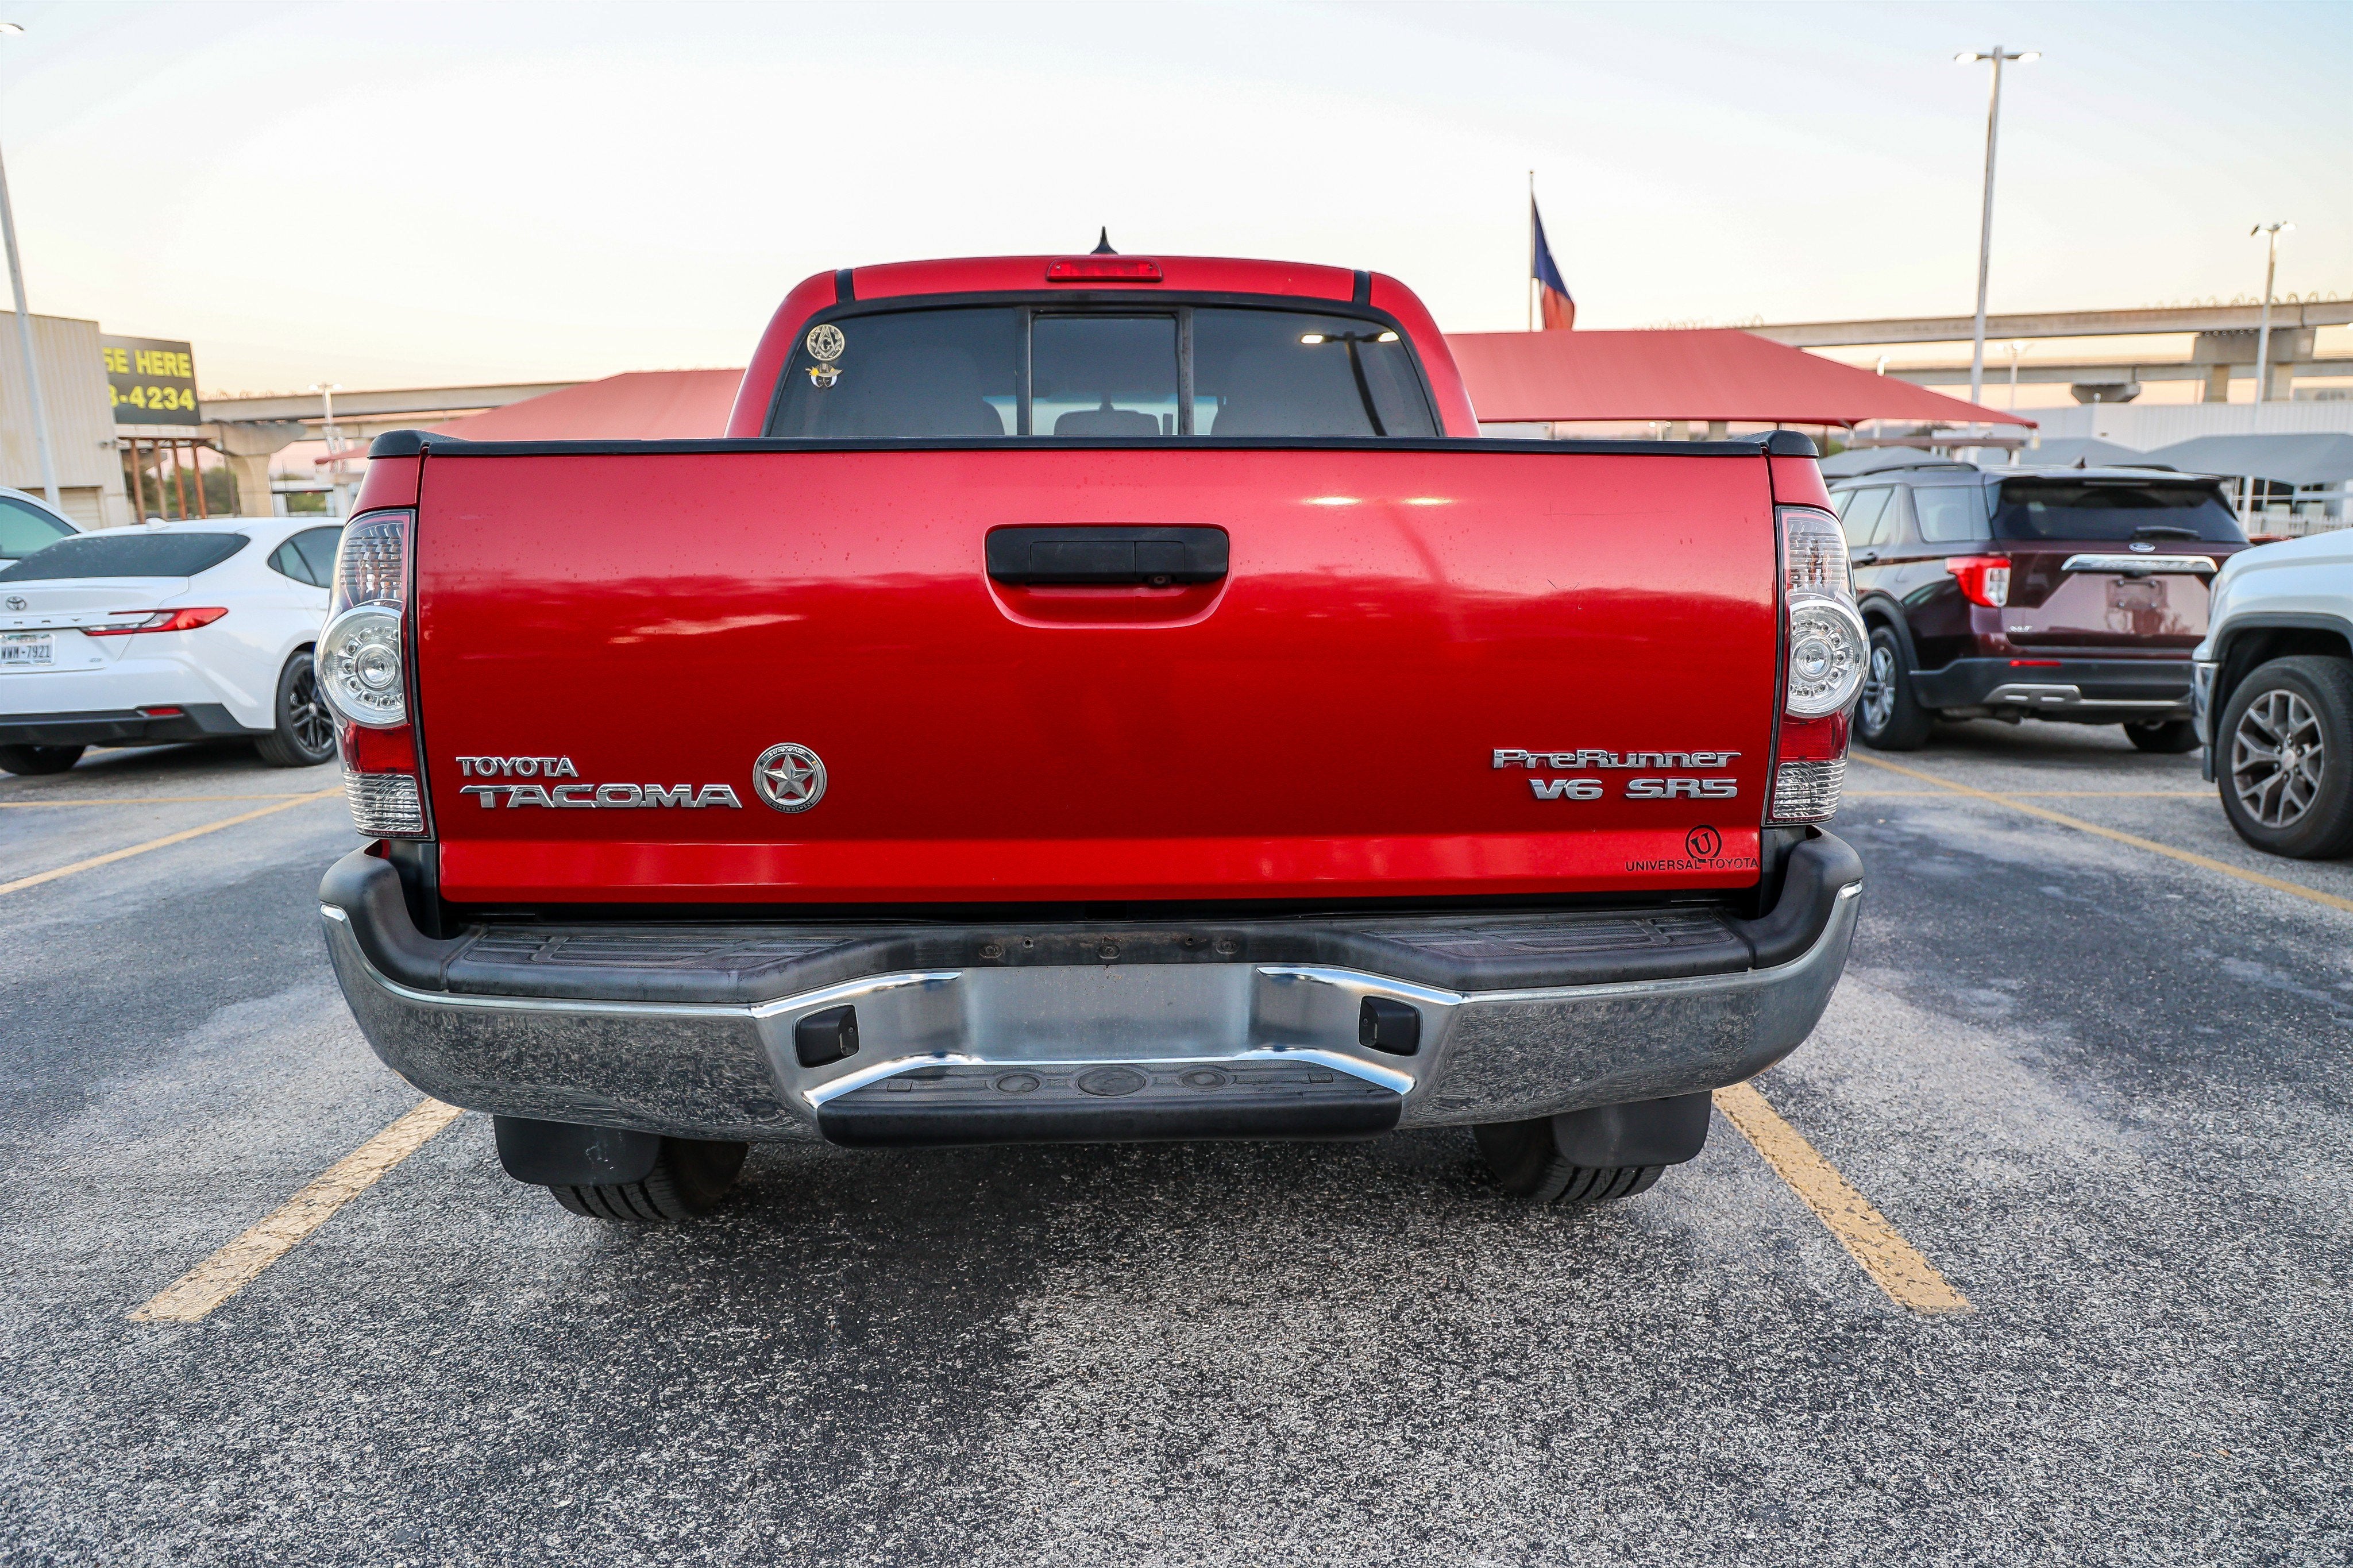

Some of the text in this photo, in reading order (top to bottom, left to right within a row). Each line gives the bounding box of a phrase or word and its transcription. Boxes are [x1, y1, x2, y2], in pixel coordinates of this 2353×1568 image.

[134, 349, 193, 379] HERE
[769, 746, 805, 757] TEXAS
[1493, 748, 1742, 769] PreRunner
[456, 756, 580, 778] TOYOTA
[459, 783, 743, 809] TACOMA
[1528, 778, 1738, 800] V6 SR5
[770, 801, 813, 812] EDITION
[1690, 832, 1712, 855] U
[1625, 858, 1760, 872] UNIVERSAL TOYOTA
